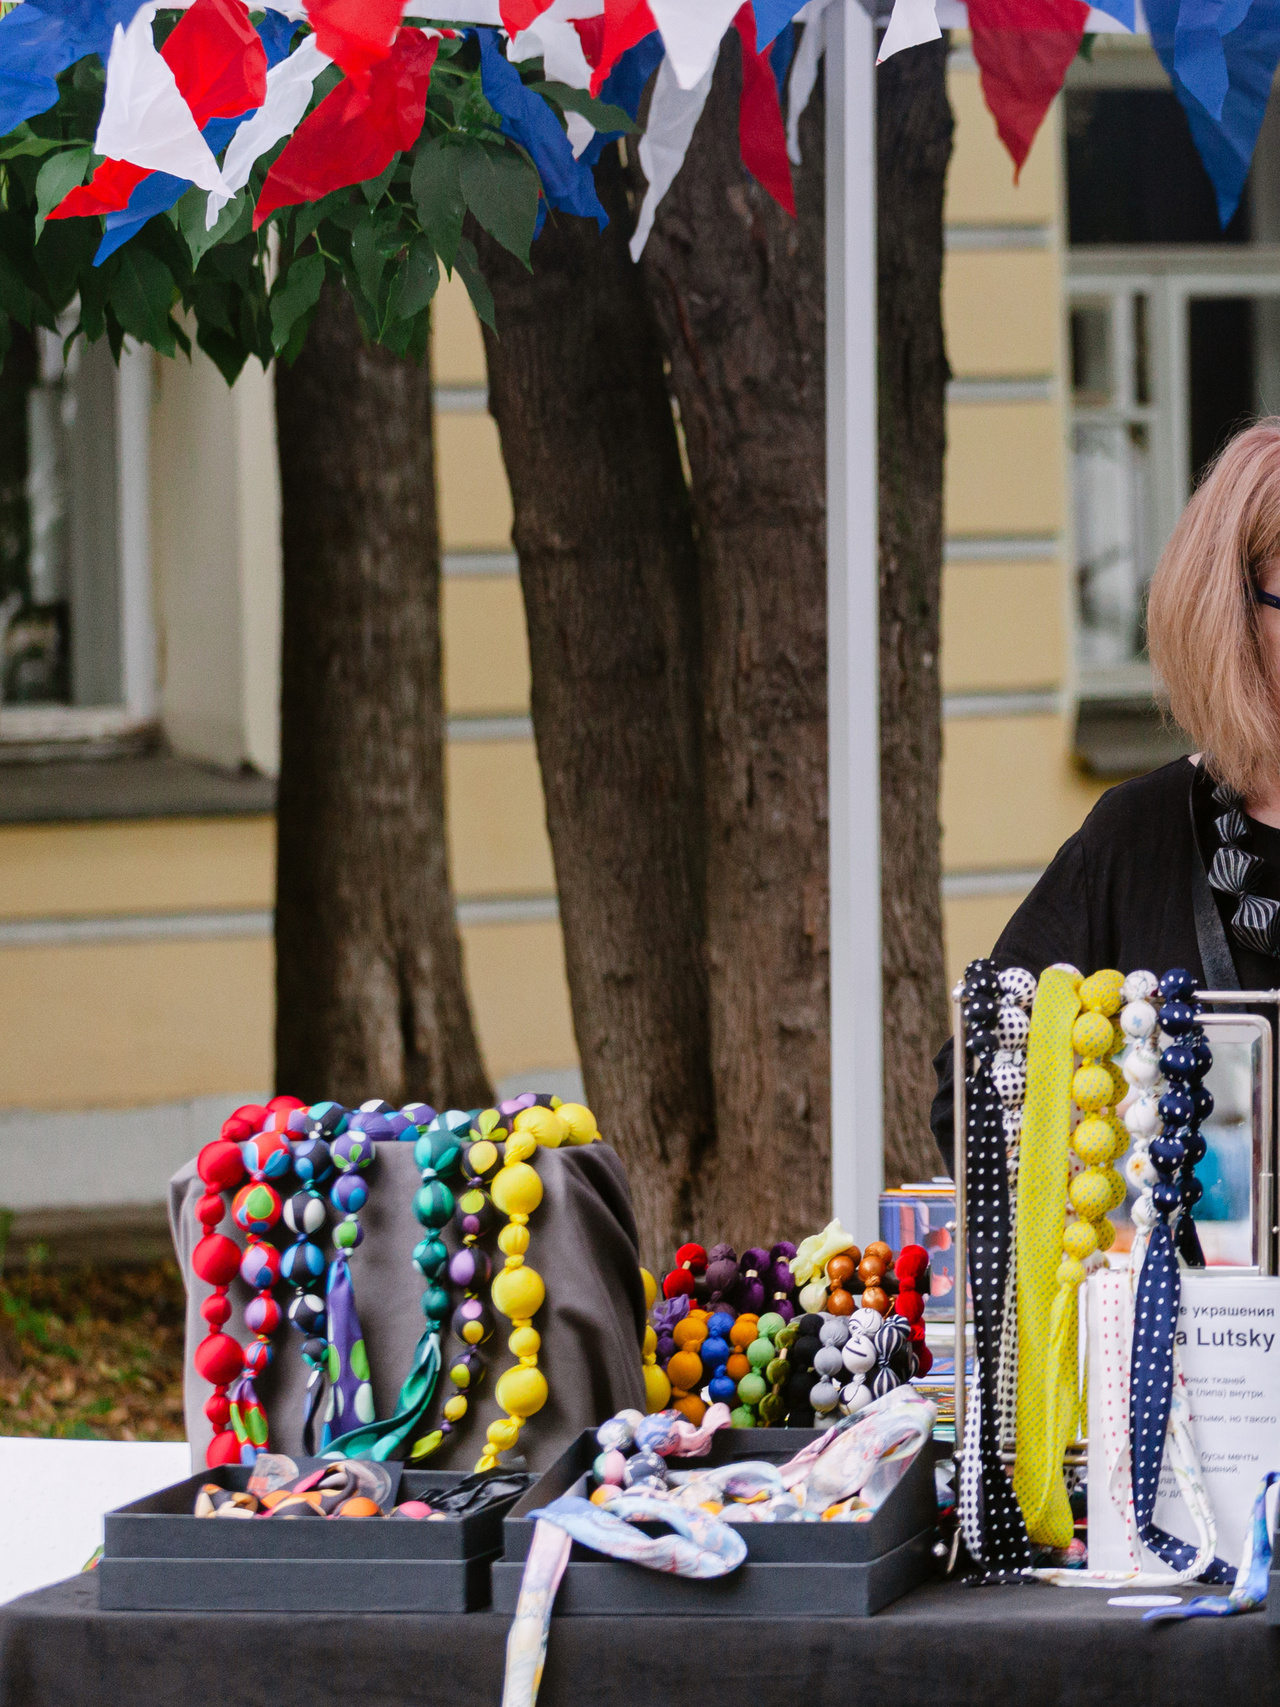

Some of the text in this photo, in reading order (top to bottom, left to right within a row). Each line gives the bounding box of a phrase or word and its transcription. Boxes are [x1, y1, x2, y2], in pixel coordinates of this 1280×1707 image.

[1193, 1306, 1275, 1318] украшения
[1197, 1328, 1275, 1352] Lutsky
[1244, 1416, 1277, 1424] такого
